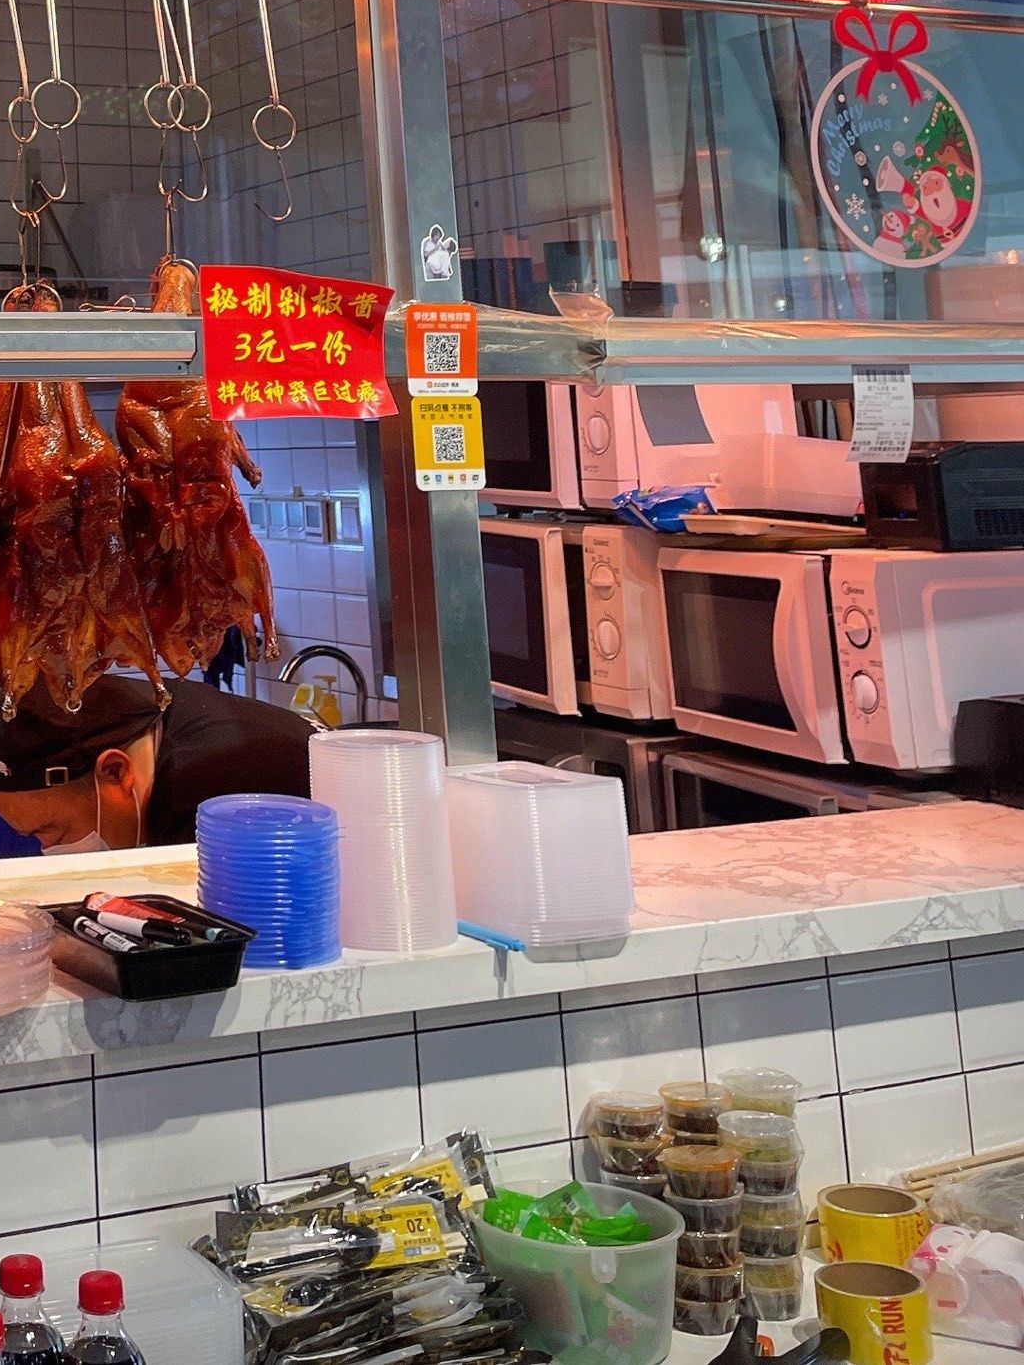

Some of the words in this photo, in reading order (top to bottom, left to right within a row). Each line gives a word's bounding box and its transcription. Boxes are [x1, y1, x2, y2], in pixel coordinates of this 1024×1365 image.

[205, 281, 380, 320] 秘制剁椒酱
[234, 329, 353, 366] 3元一份
[216, 378, 381, 405] 拌饭神器巨过瘾
